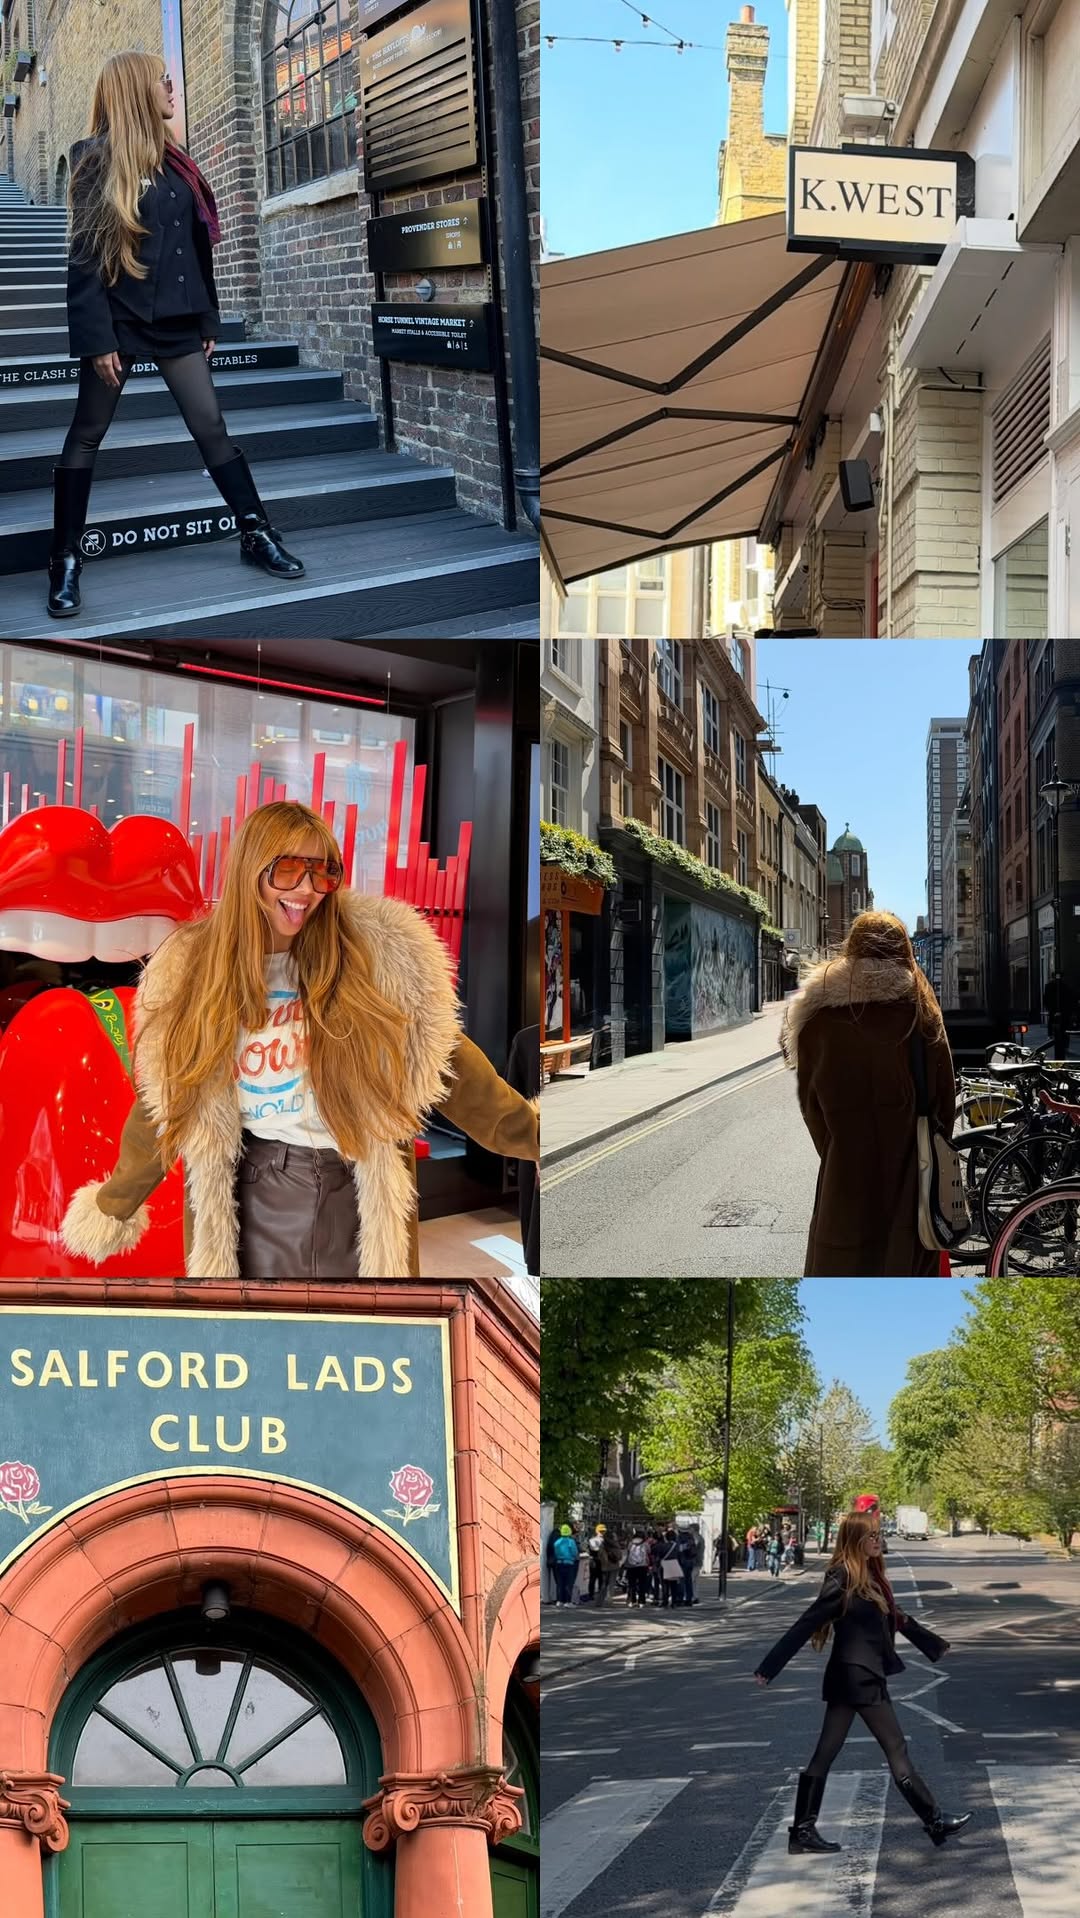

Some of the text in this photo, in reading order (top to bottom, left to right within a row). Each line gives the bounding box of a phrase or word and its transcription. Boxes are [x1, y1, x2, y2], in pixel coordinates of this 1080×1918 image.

[800, 178, 952, 218] K.WEST
[401, 218, 460, 234] PROVENDER STORES
[378, 316, 466, 327] HORSE TUNNEL VINTAGE MARKET
[425, 330, 450, 338] ACCESSIBLE
[0, 373, 20, 383] HE
[24, 369, 66, 381] CLASH
[212, 355, 258, 366] STABLES
[112, 530, 138, 547] DO
[143, 524, 180, 542] NOT
[186, 519, 213, 536] SIT
[10, 1348, 413, 1394] SALFORD LADS
[149, 1413, 288, 1455] CLUB
